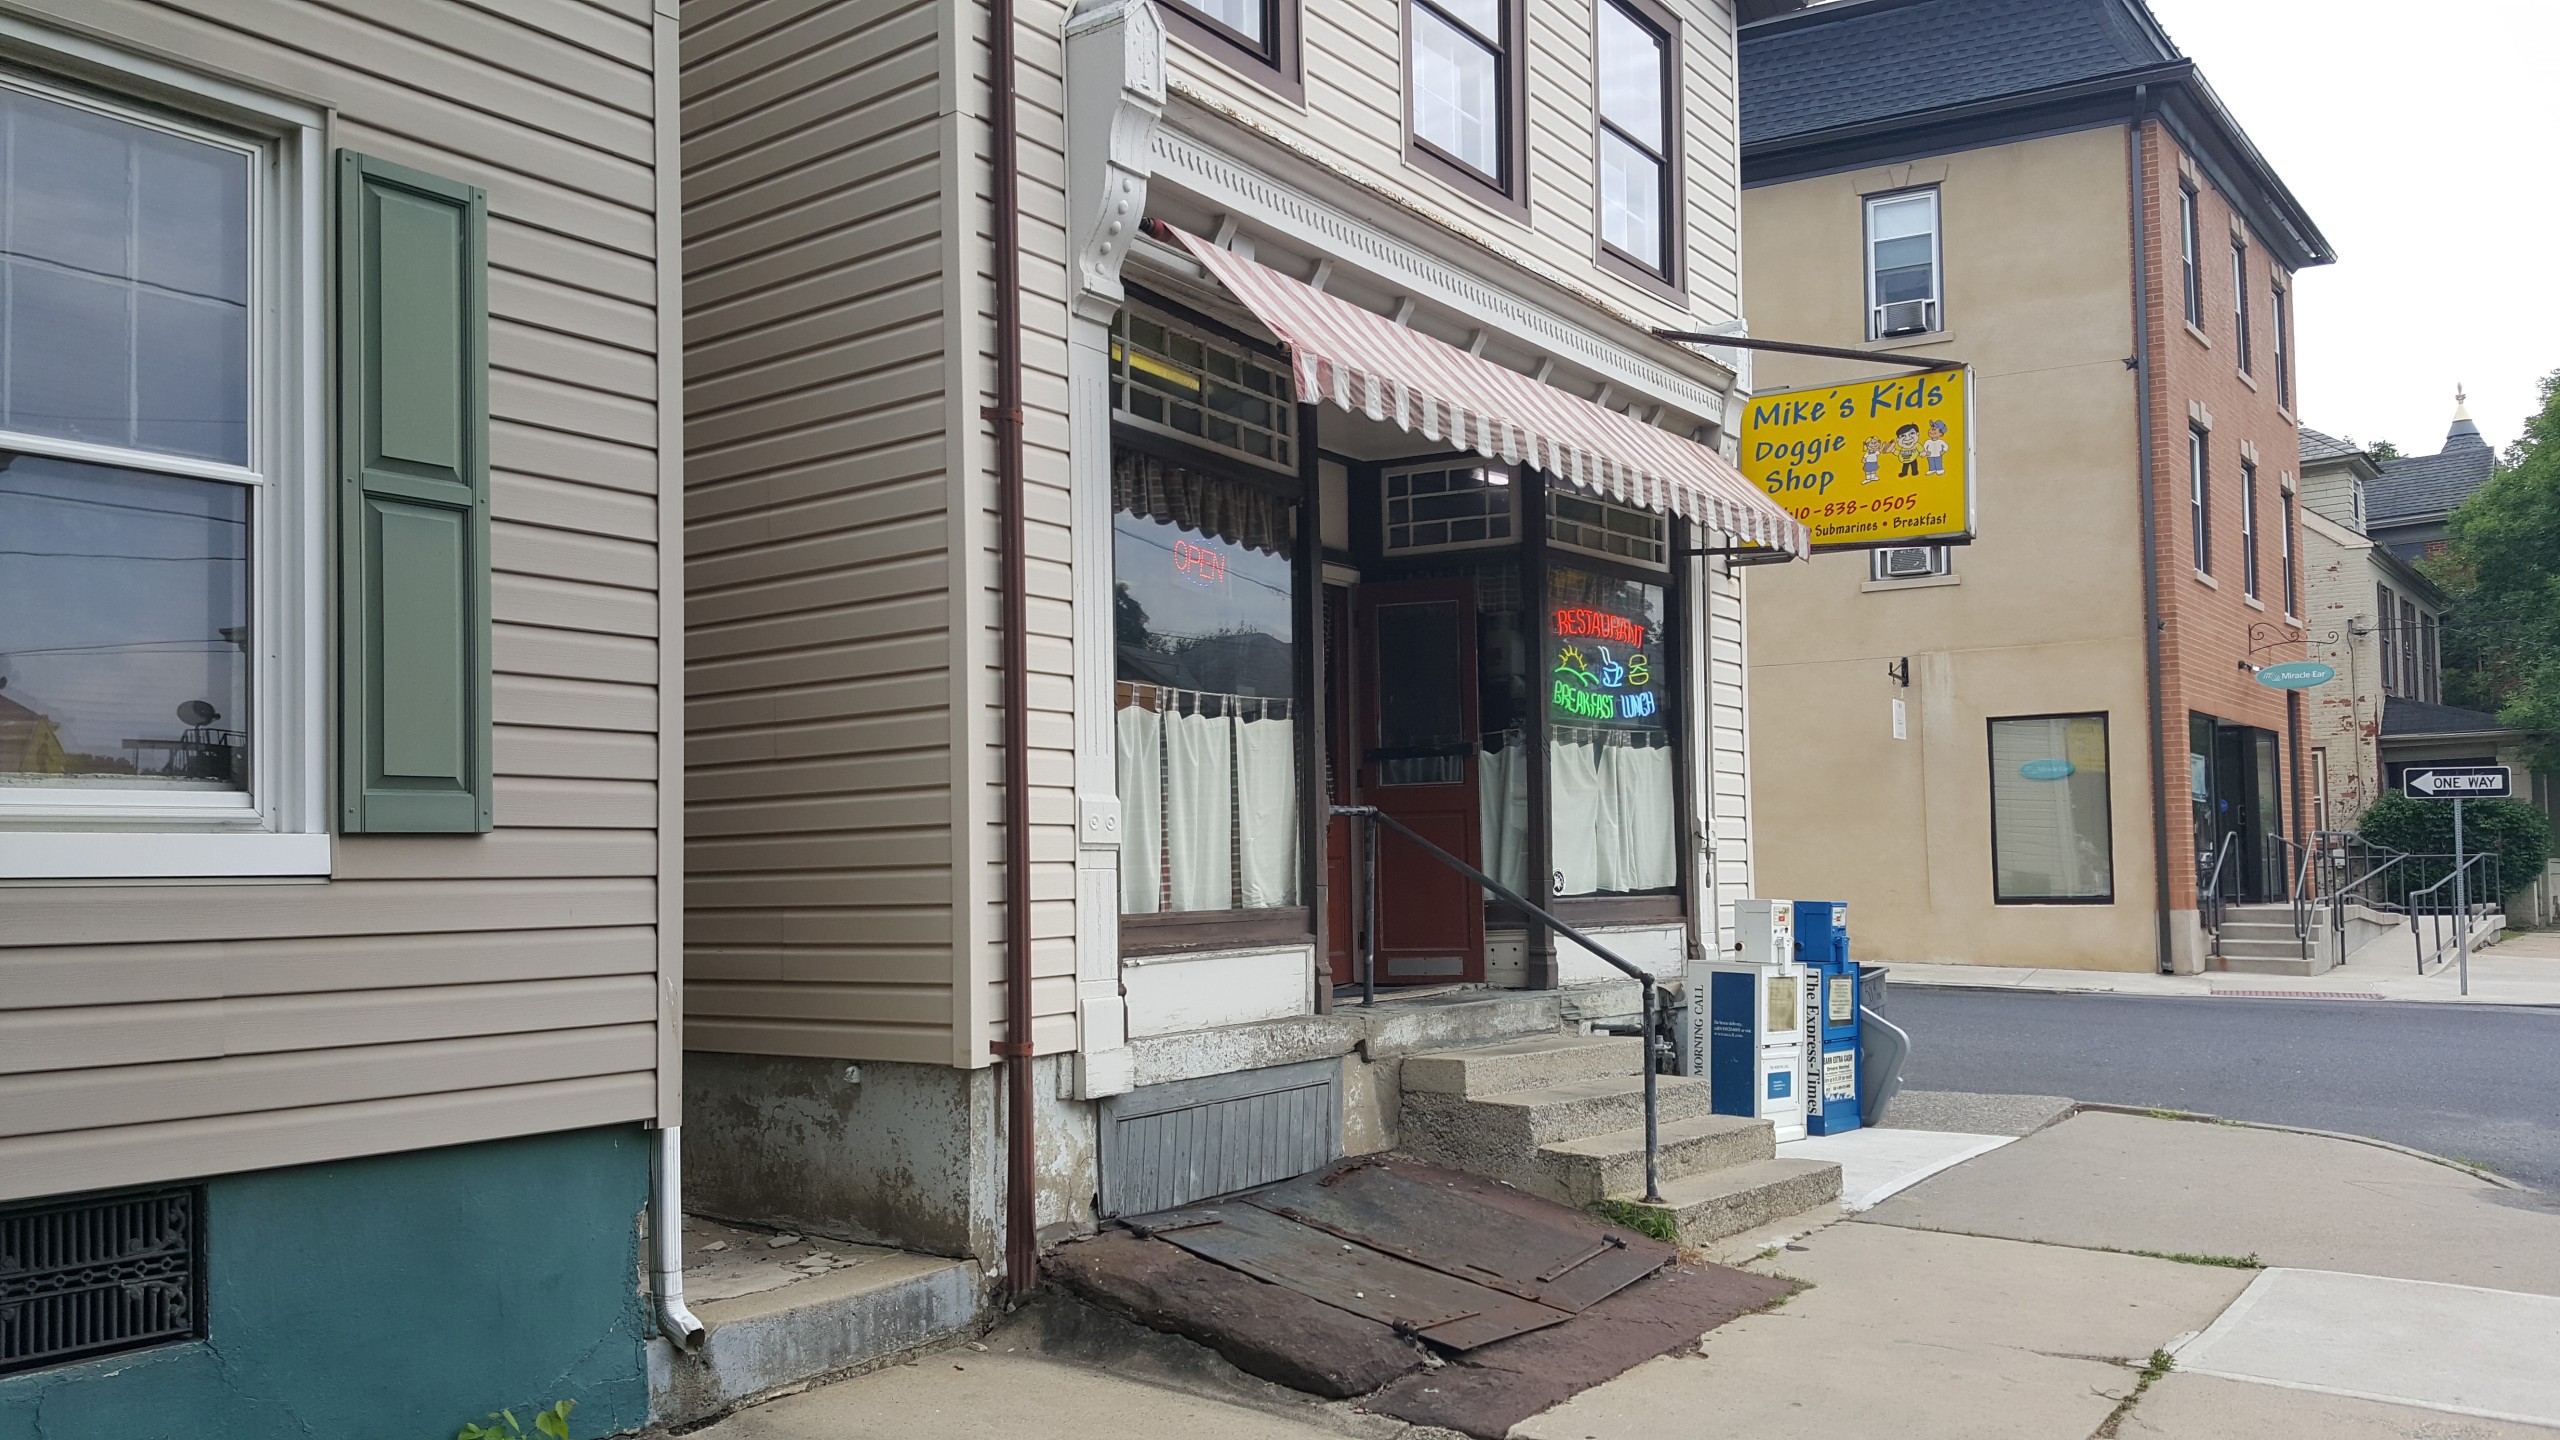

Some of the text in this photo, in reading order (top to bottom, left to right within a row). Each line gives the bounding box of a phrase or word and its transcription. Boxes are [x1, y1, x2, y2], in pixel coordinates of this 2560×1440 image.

[1753, 391, 1855, 430] Mike's
[1755, 433, 1846, 466] Doggie
[1765, 468, 1834, 495] Shop
[1815, 513, 1947, 537] Submarines Breakfast
[1174, 540, 1226, 583] OPEN
[1557, 608, 1645, 649] RESTAURANT
[1553, 680, 1656, 719] BREAKFAST LUNCH
[2433, 776, 2496, 789] ONE WAY
[1806, 971, 1819, 1000] The
[1694, 984, 1704, 1077] MORNING CALL
